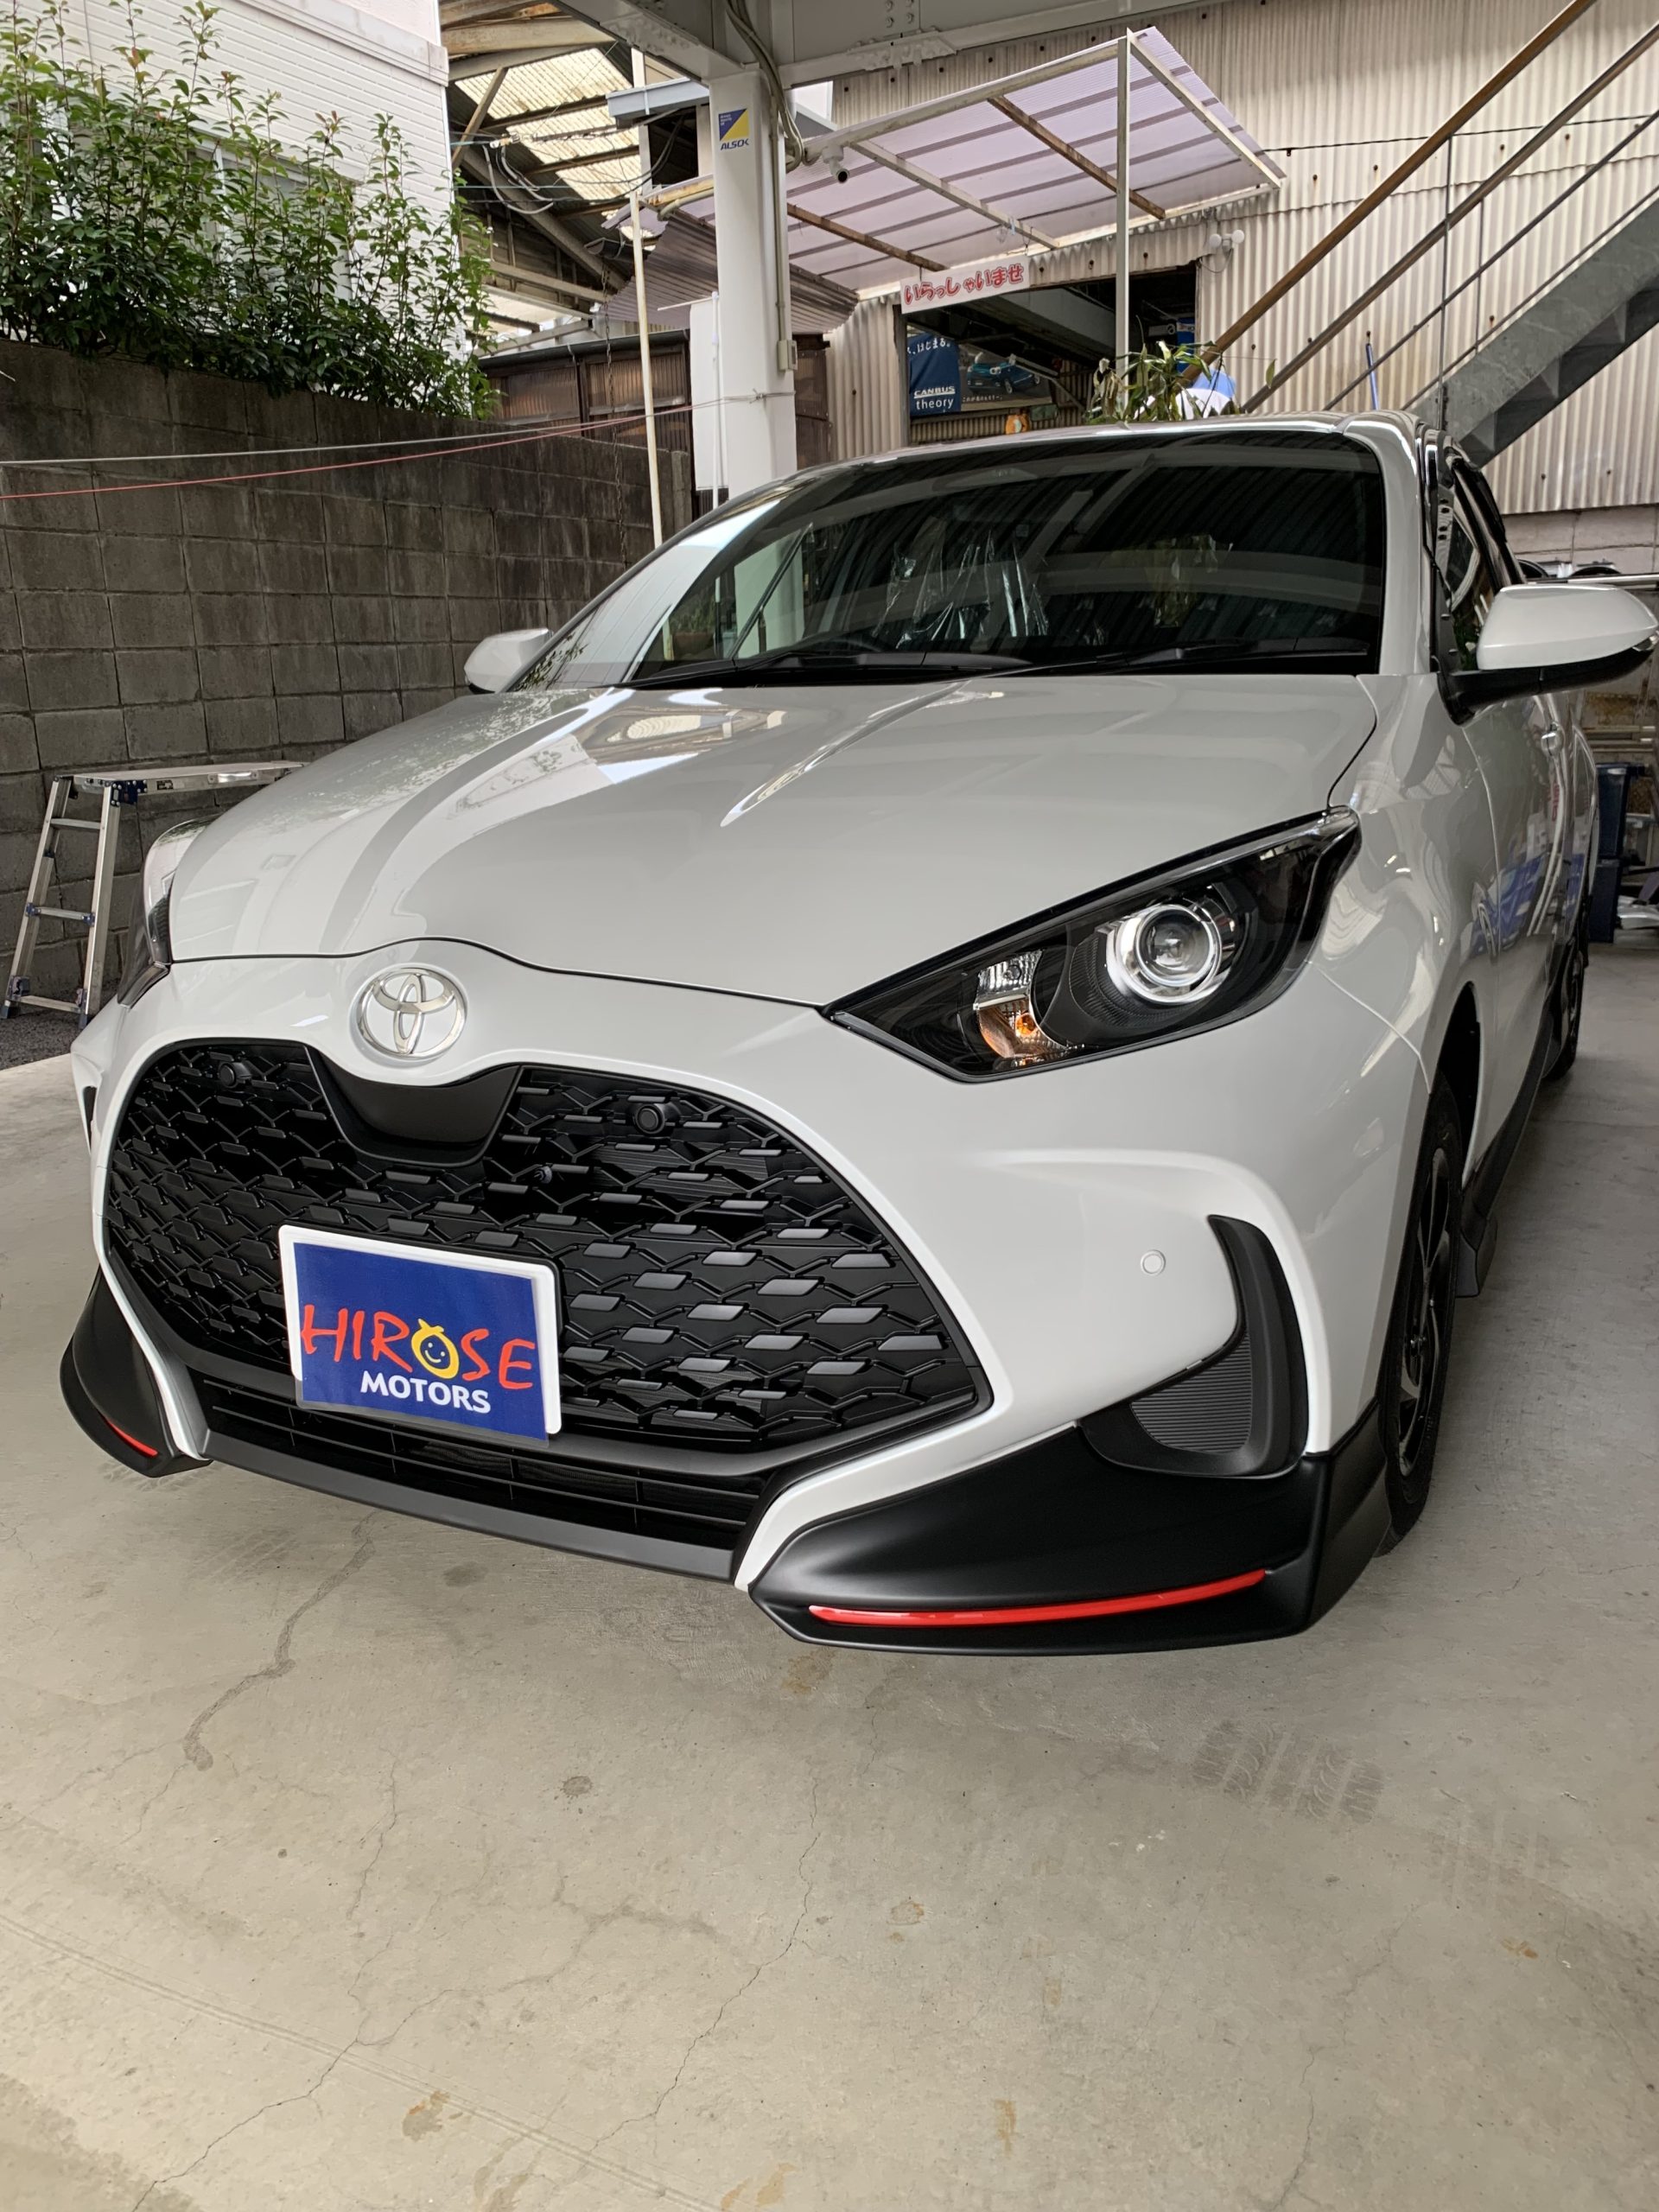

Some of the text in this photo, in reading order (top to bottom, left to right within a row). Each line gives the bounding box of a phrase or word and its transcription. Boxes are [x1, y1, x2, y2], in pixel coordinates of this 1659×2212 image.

[720, 138, 749, 150] ALSOK
[905, 264, 1024, 305] いらっしゃいませ
[913, 385, 956, 398] CANBUS
[916, 398, 954, 410] theory
[301, 1304, 536, 1389] HIROSE
[360, 1370, 492, 1414] MOTORS
